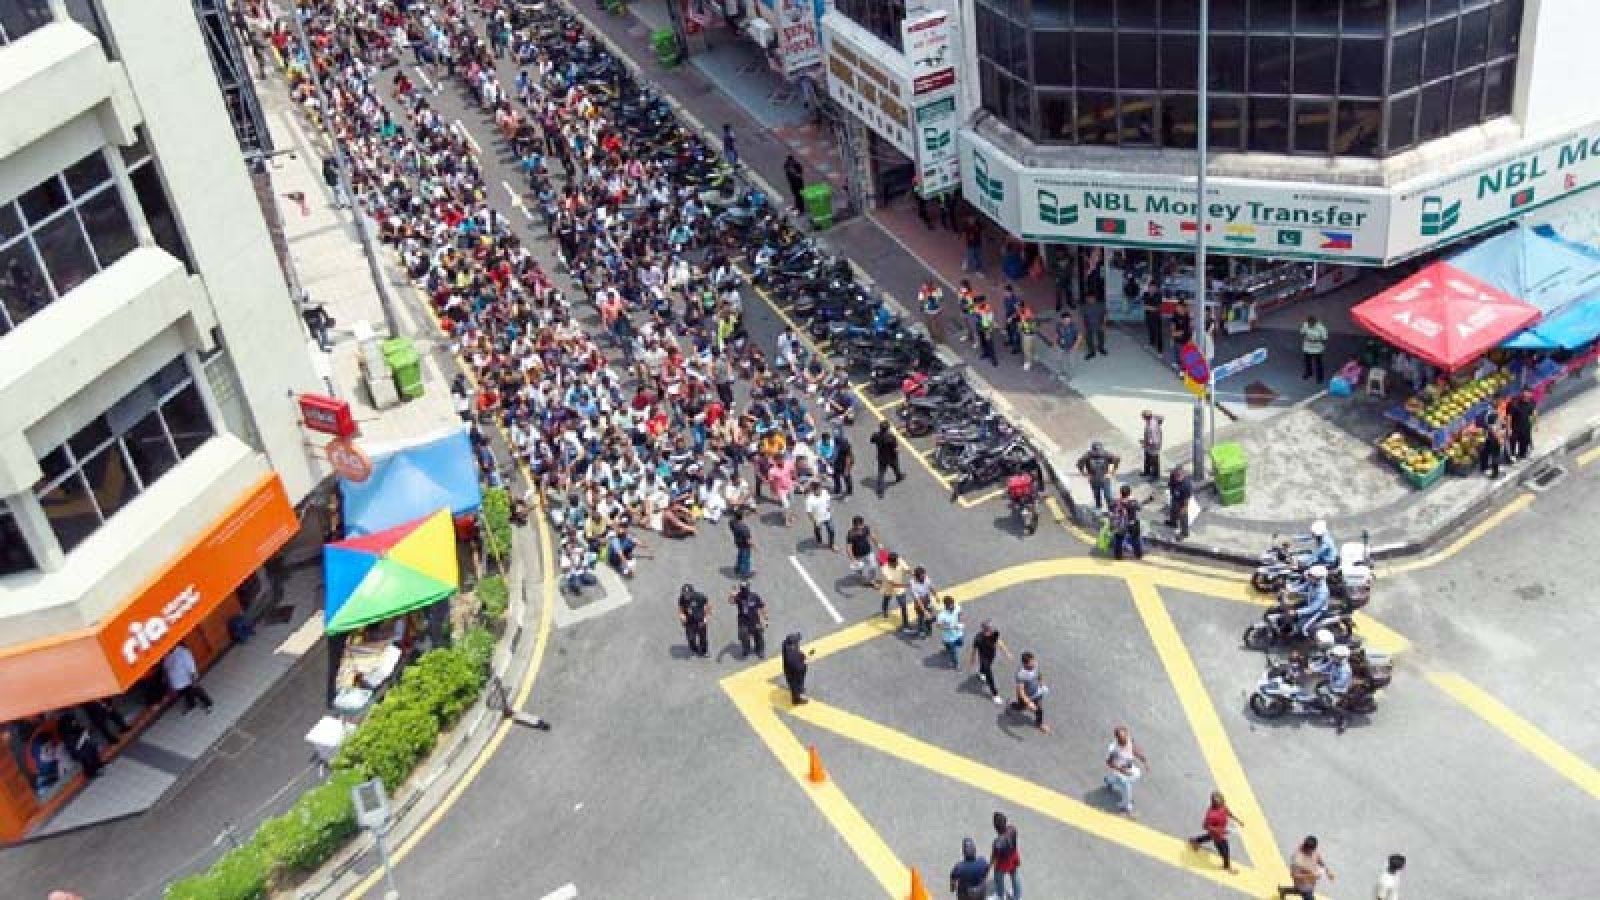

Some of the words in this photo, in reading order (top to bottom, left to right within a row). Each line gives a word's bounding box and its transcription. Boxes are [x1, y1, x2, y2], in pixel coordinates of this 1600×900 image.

[1477, 155, 1547, 199] NBL
[1083, 191, 1138, 213] NBL
[1246, 201, 1369, 227] Transfer
